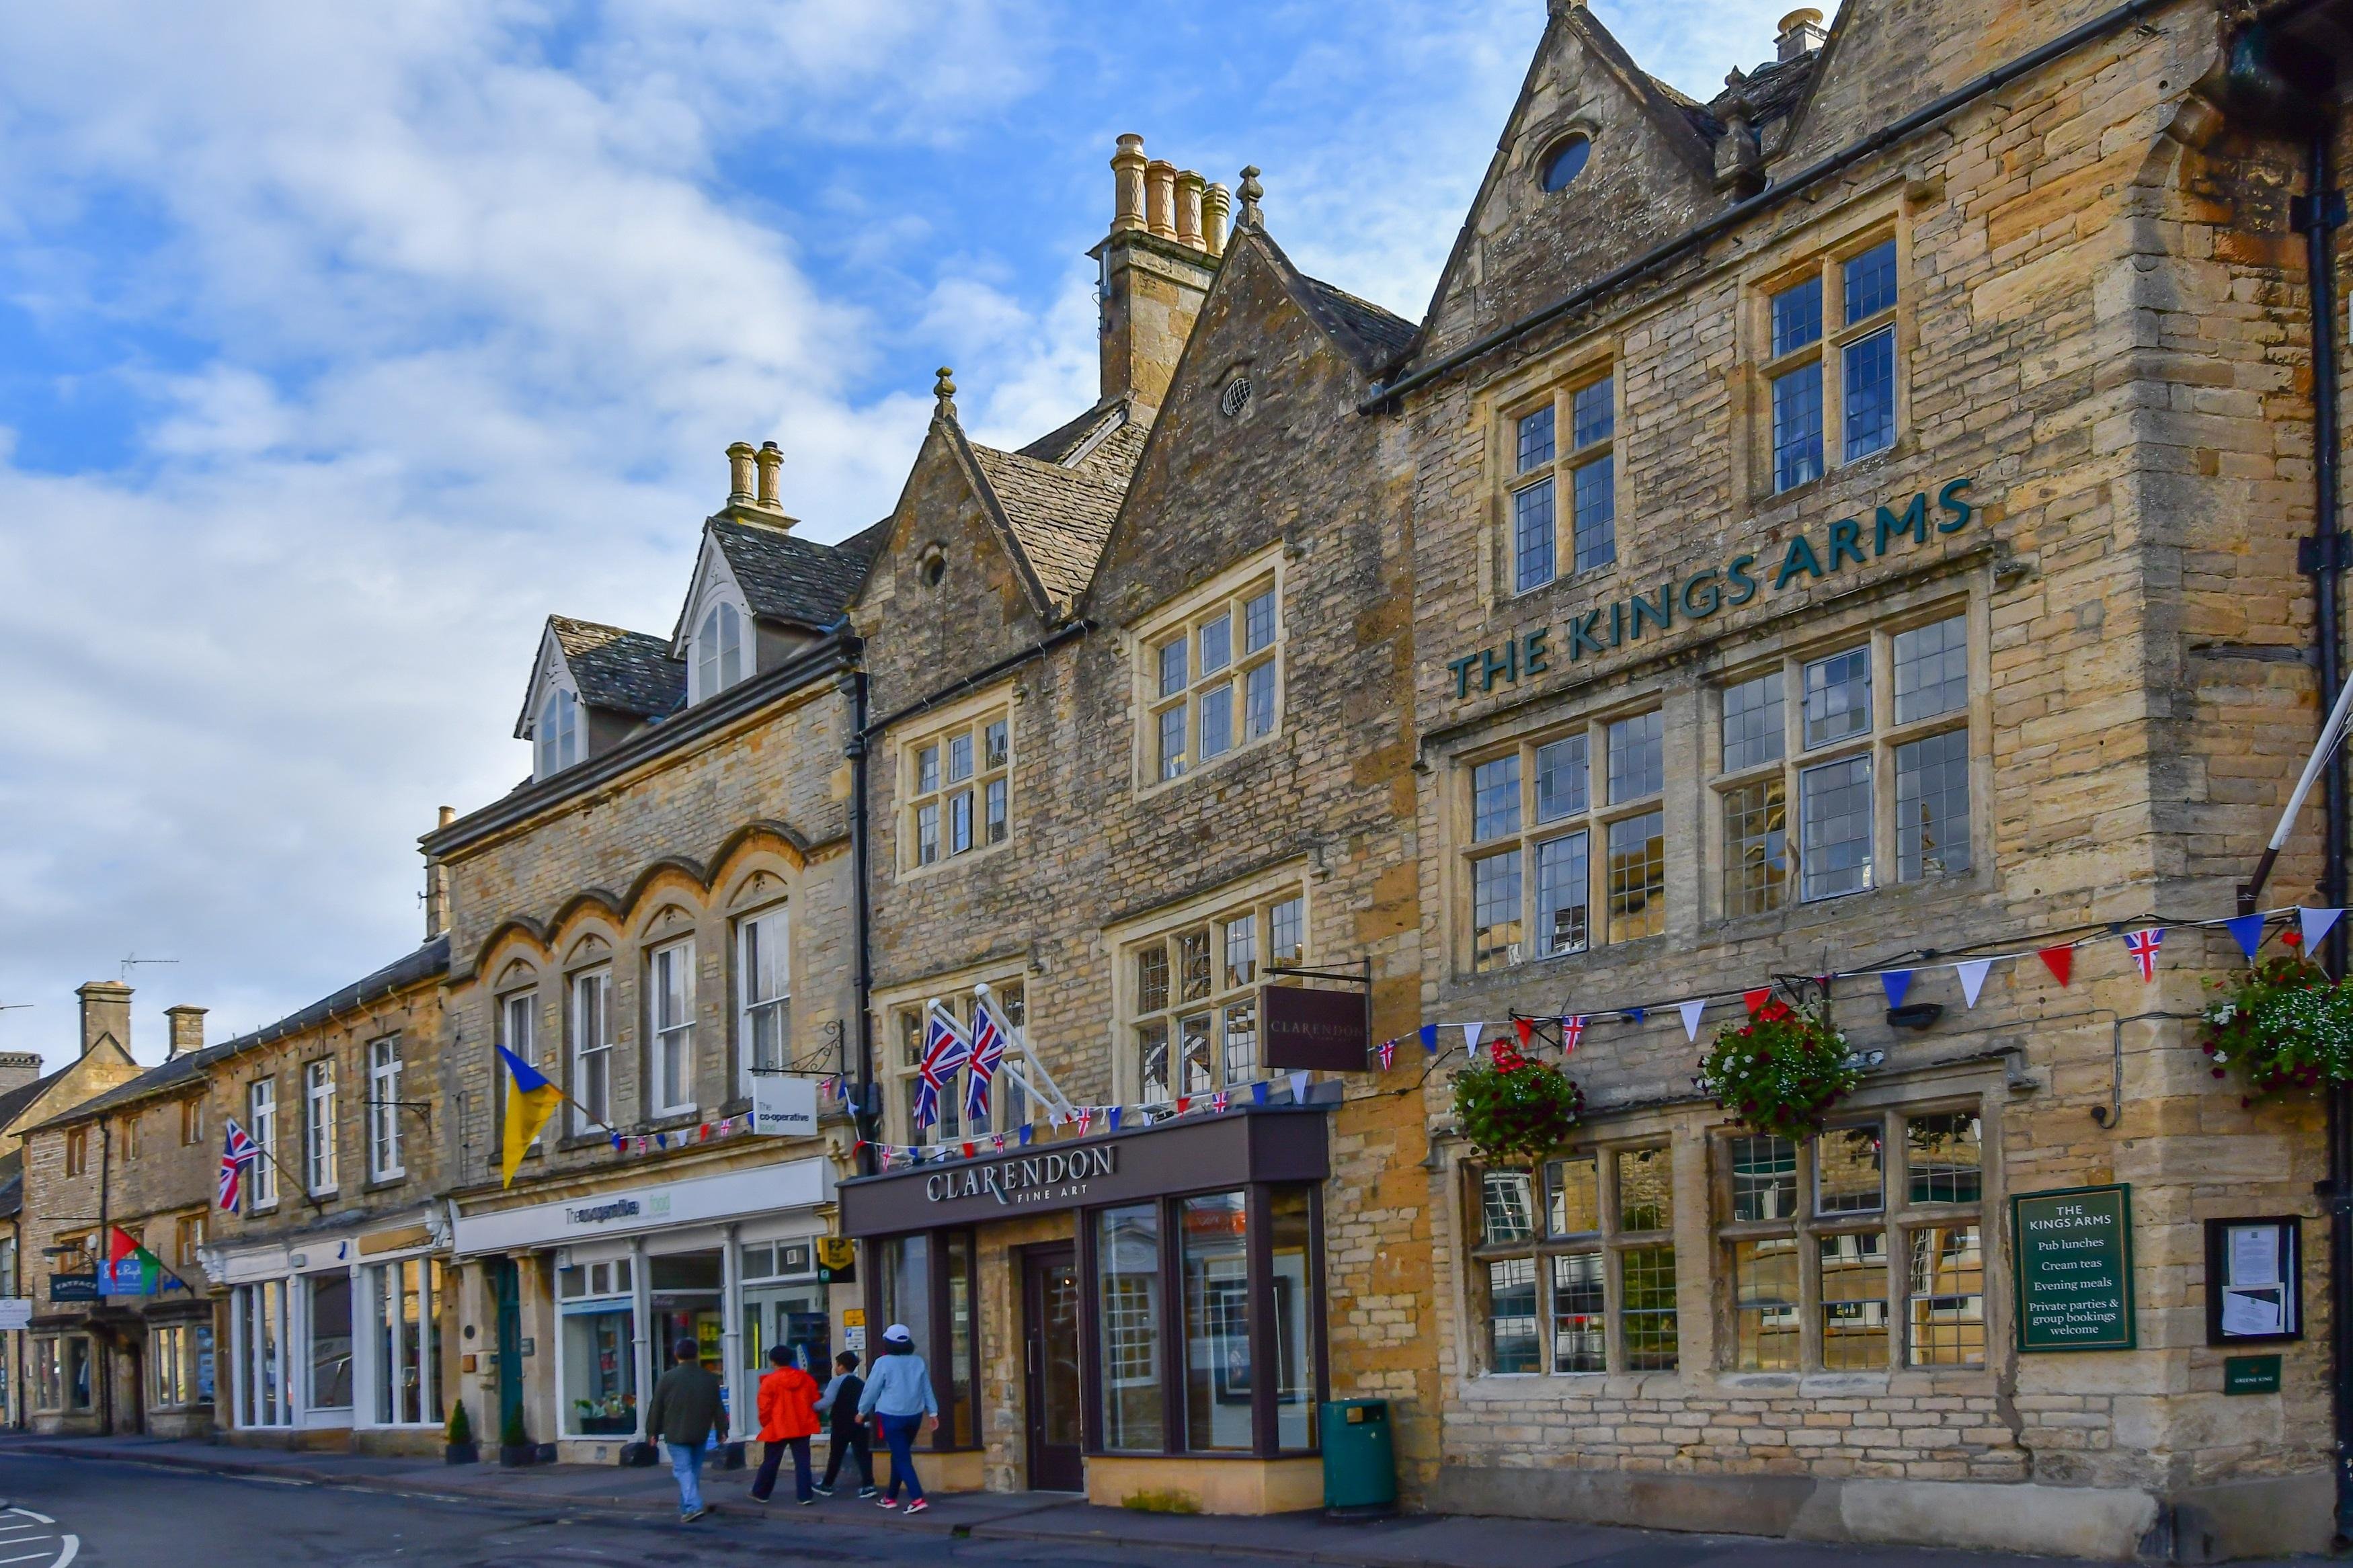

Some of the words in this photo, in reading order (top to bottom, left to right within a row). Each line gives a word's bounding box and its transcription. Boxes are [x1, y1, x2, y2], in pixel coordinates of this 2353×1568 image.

[1447, 627, 1548, 700] THE
[1568, 555, 1755, 661] KINGS
[1774, 478, 1972, 590] ARMS
[1271, 1020, 1364, 1039] CLARENDON
[758, 1102, 772, 1111] The
[759, 1113, 809, 1122] co-operative
[926, 1145, 1116, 1204] CLARENDON
[1017, 1190, 1050, 1204] FINE
[1060, 1184, 1088, 1197] ART
[565, 1208, 580, 1225] The
[2056, 1205, 2083, 1216] THE
[2030, 1218, 2071, 1231] KINGS
[2074, 1214, 2112, 1227] ARMS
[2038, 1240, 2059, 1251] Pub
[2062, 1238, 2104, 1249] lunches
[2041, 1262, 2077, 1271] Cream
[2080, 1260, 2102, 1268] teas
[2034, 1280, 2078, 1292] Evening
[2080, 1277, 2112, 1288] meals
[2028, 1302, 2067, 1312] Private
[2069, 1299, 2107, 1312] parties
[2109, 1298, 2119, 1308] &
[2032, 1315, 2065, 1326] group
[2067, 1312, 2116, 1323] bookings
[2050, 1325, 2099, 1335] welcome
